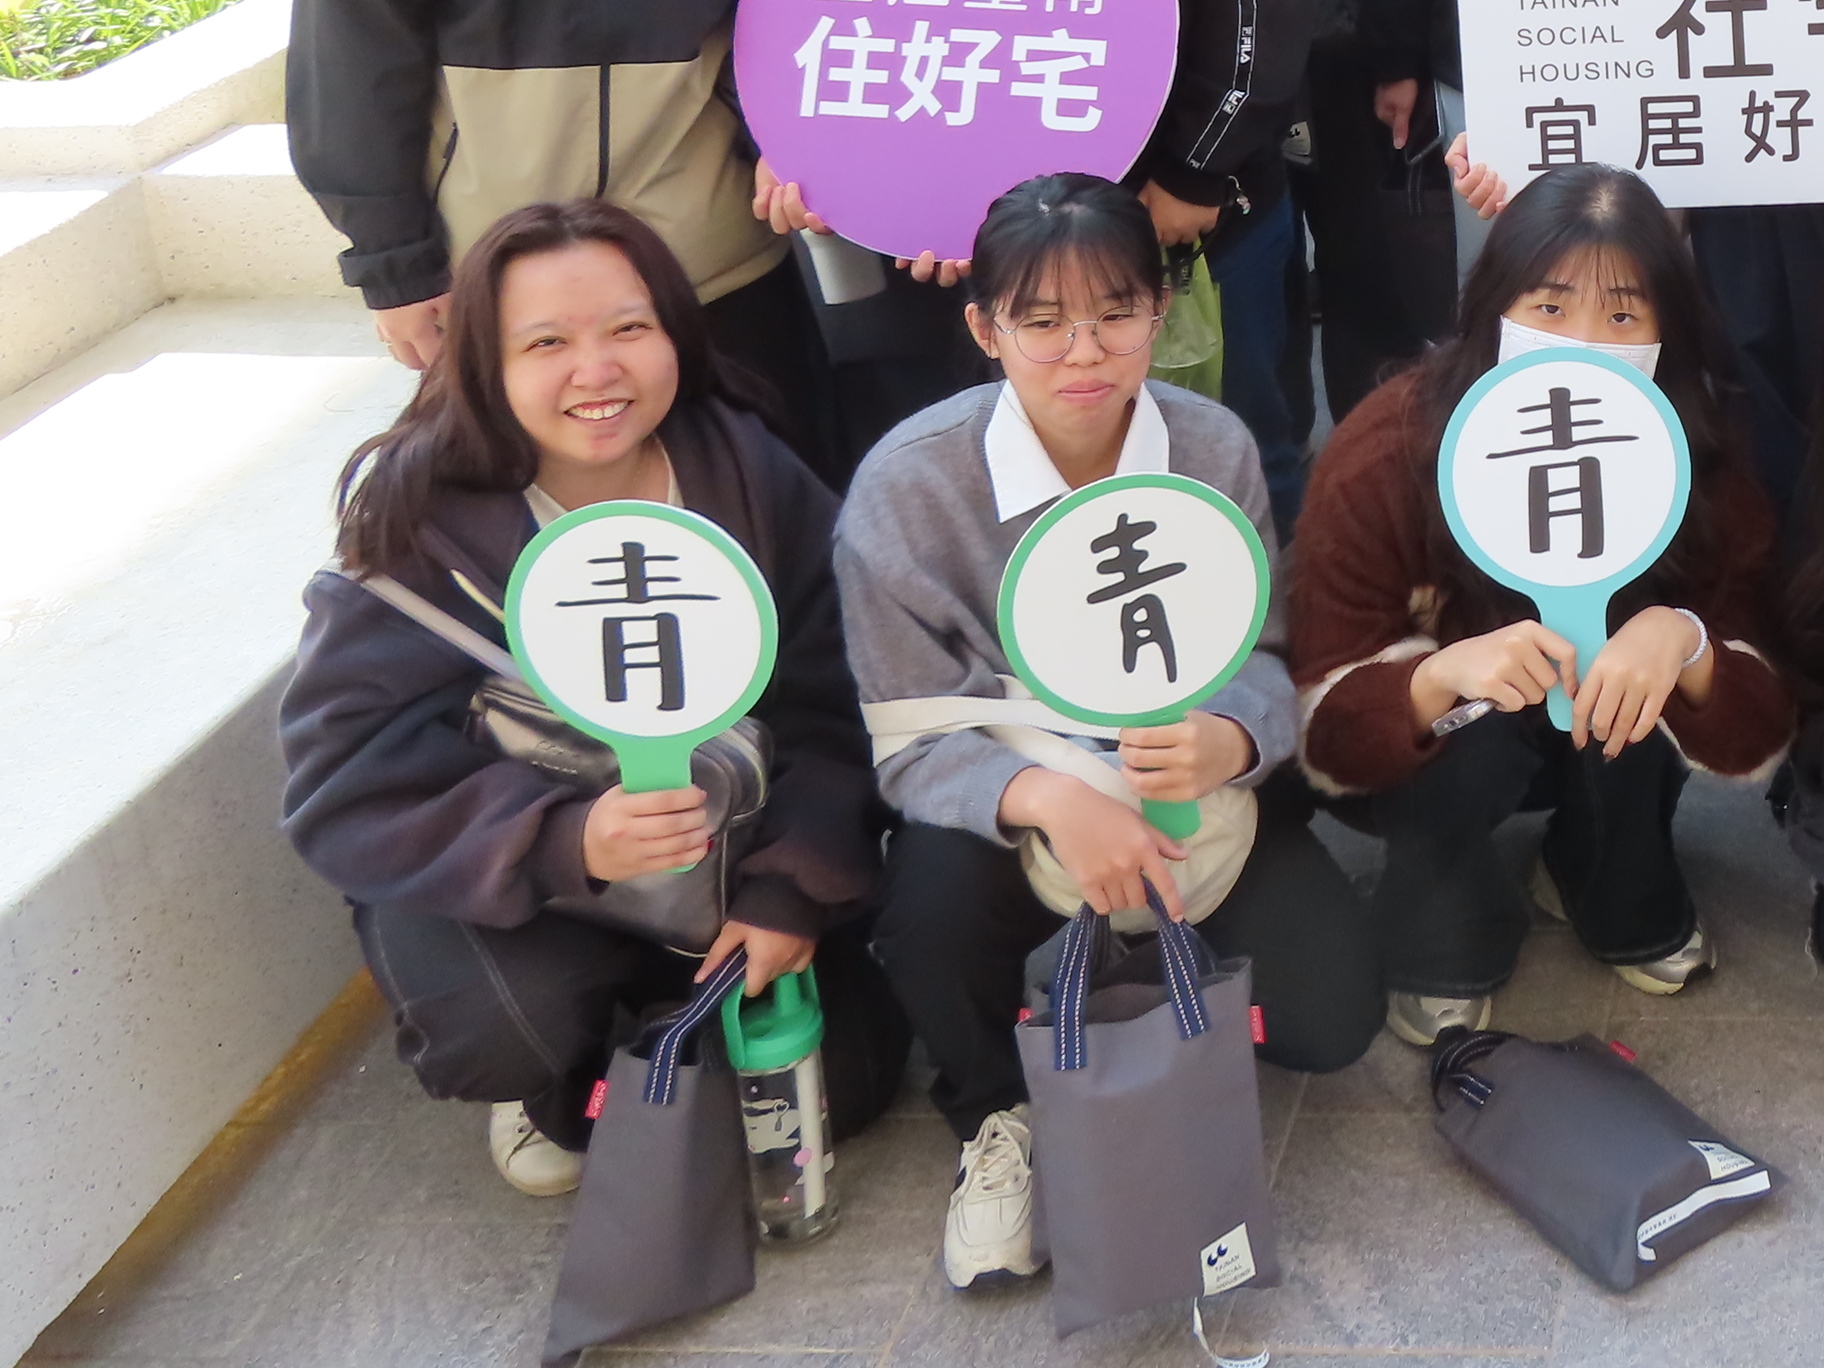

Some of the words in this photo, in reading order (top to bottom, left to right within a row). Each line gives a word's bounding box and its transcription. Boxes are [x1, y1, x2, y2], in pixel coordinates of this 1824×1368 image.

[793, 15, 1108, 132] 住好宅
[1516, 24, 1625, 48] SOCIAL
[1519, 59, 1656, 84] HOUSING
[1485, 387, 1640, 559] 青
[554, 541, 722, 712] 青
[1086, 513, 1188, 684] 青
